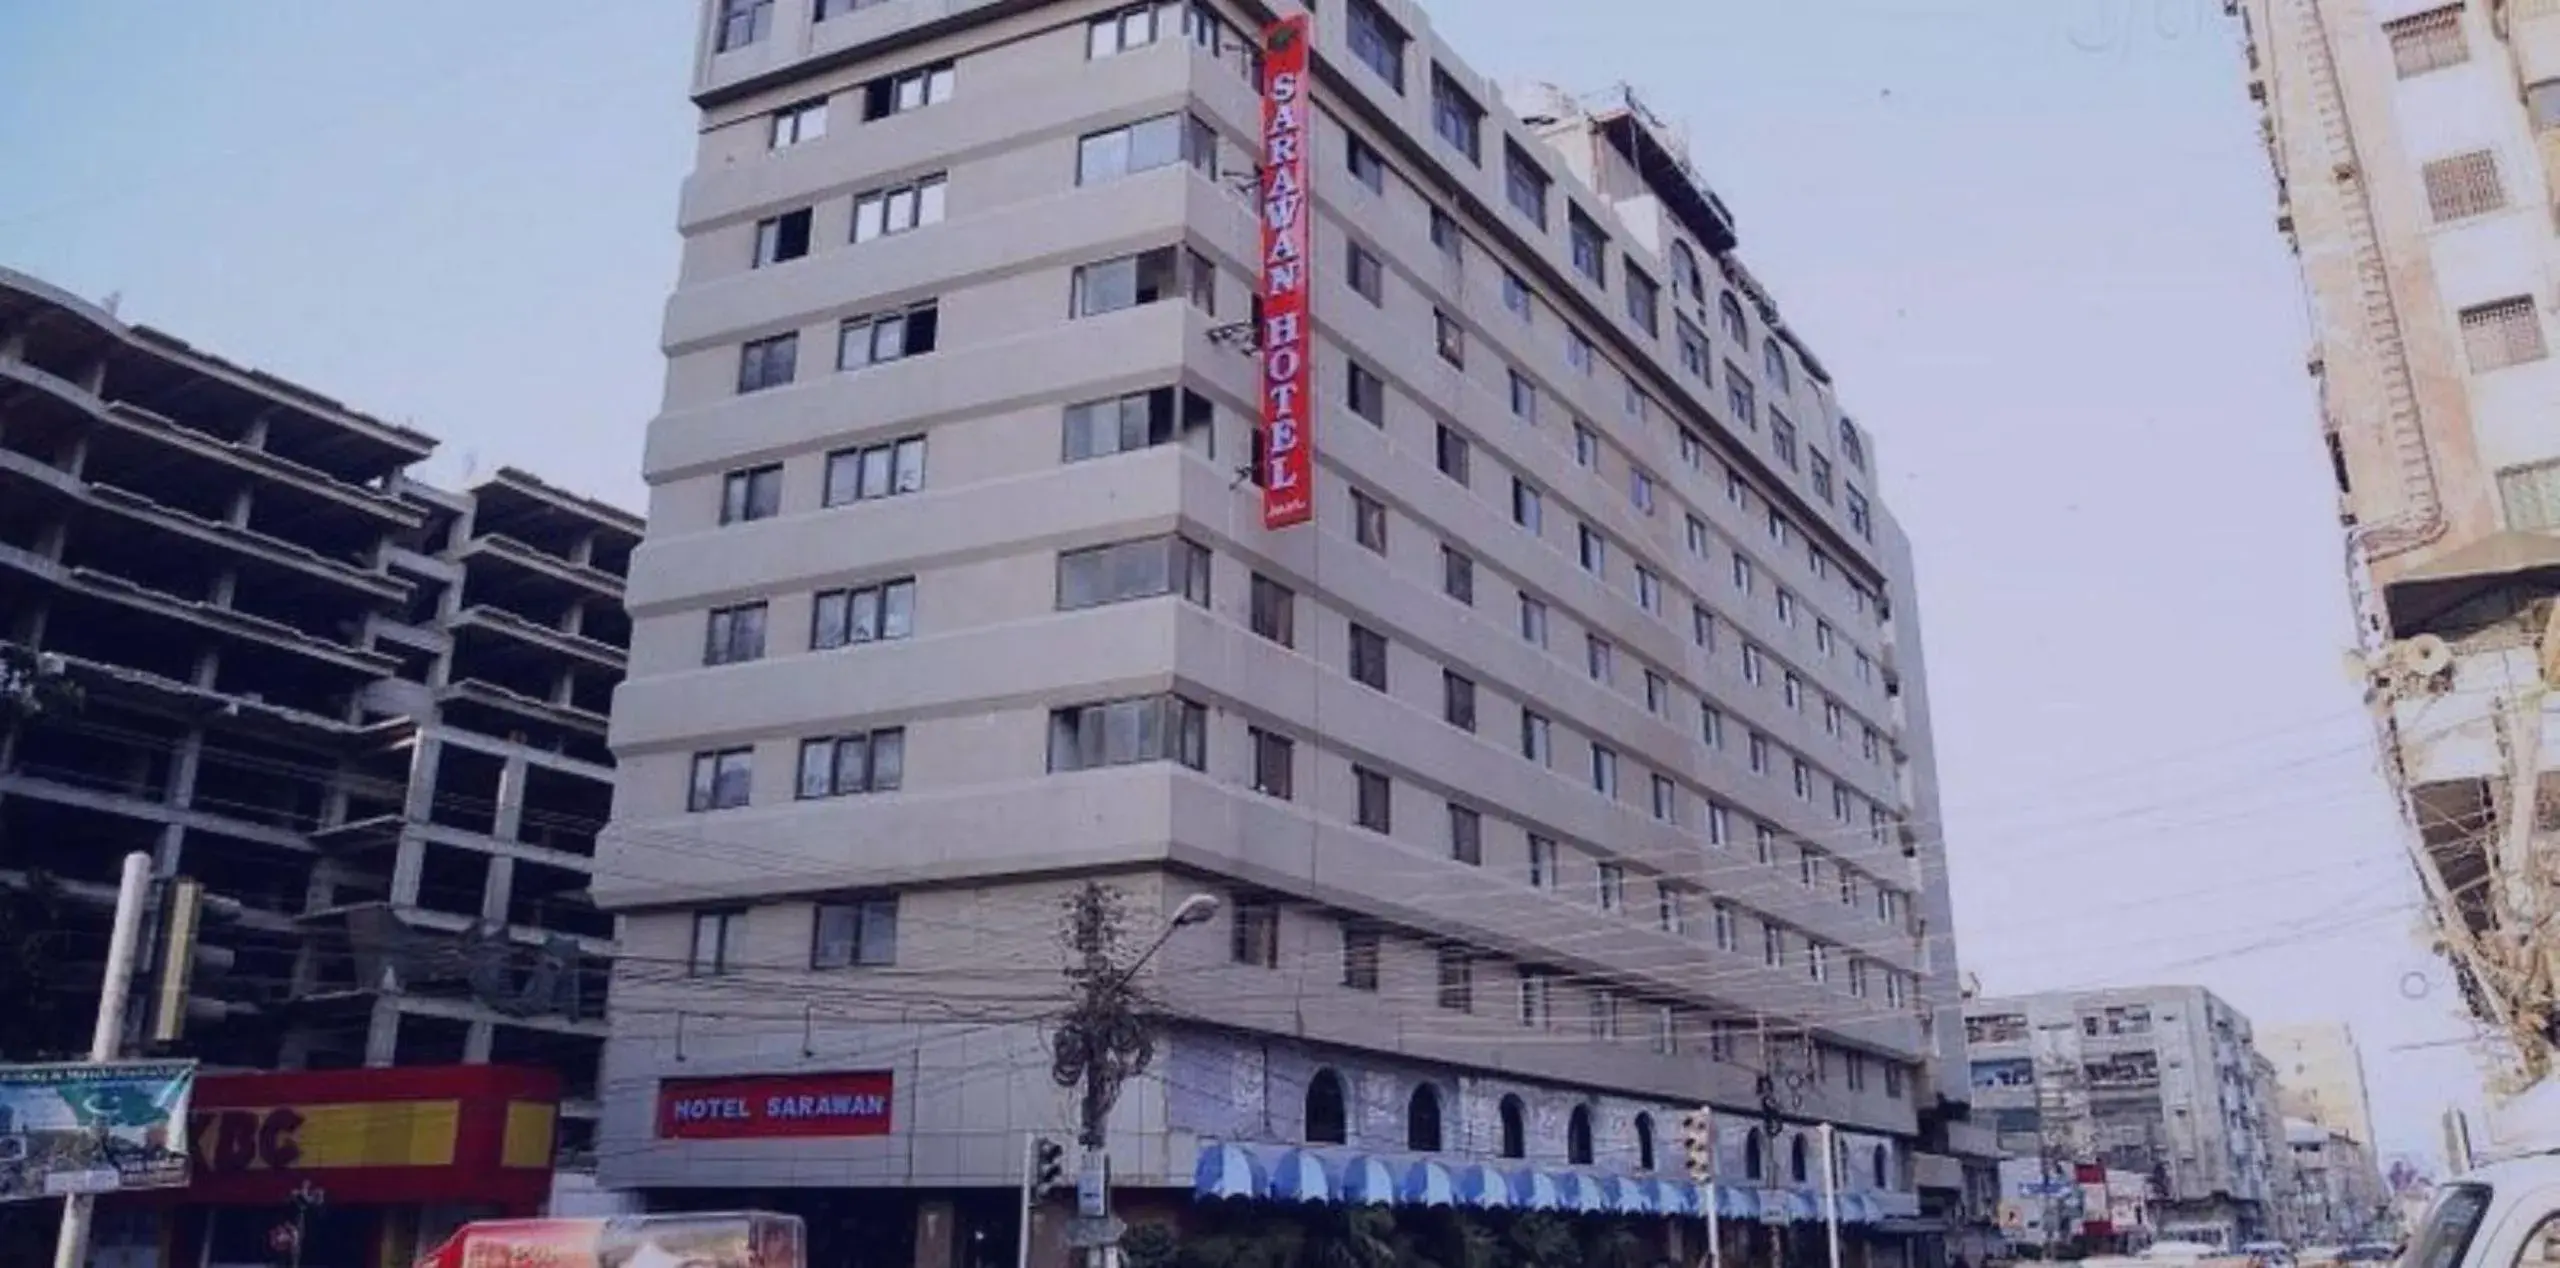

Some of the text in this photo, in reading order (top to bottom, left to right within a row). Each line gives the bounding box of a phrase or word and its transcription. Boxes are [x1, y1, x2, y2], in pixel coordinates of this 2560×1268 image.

[1265, 72, 1300, 294] SARAWAN
[1267, 312, 1301, 491] HOTEL
[673, 1094, 886, 1120] HOTEL SARAWAN
